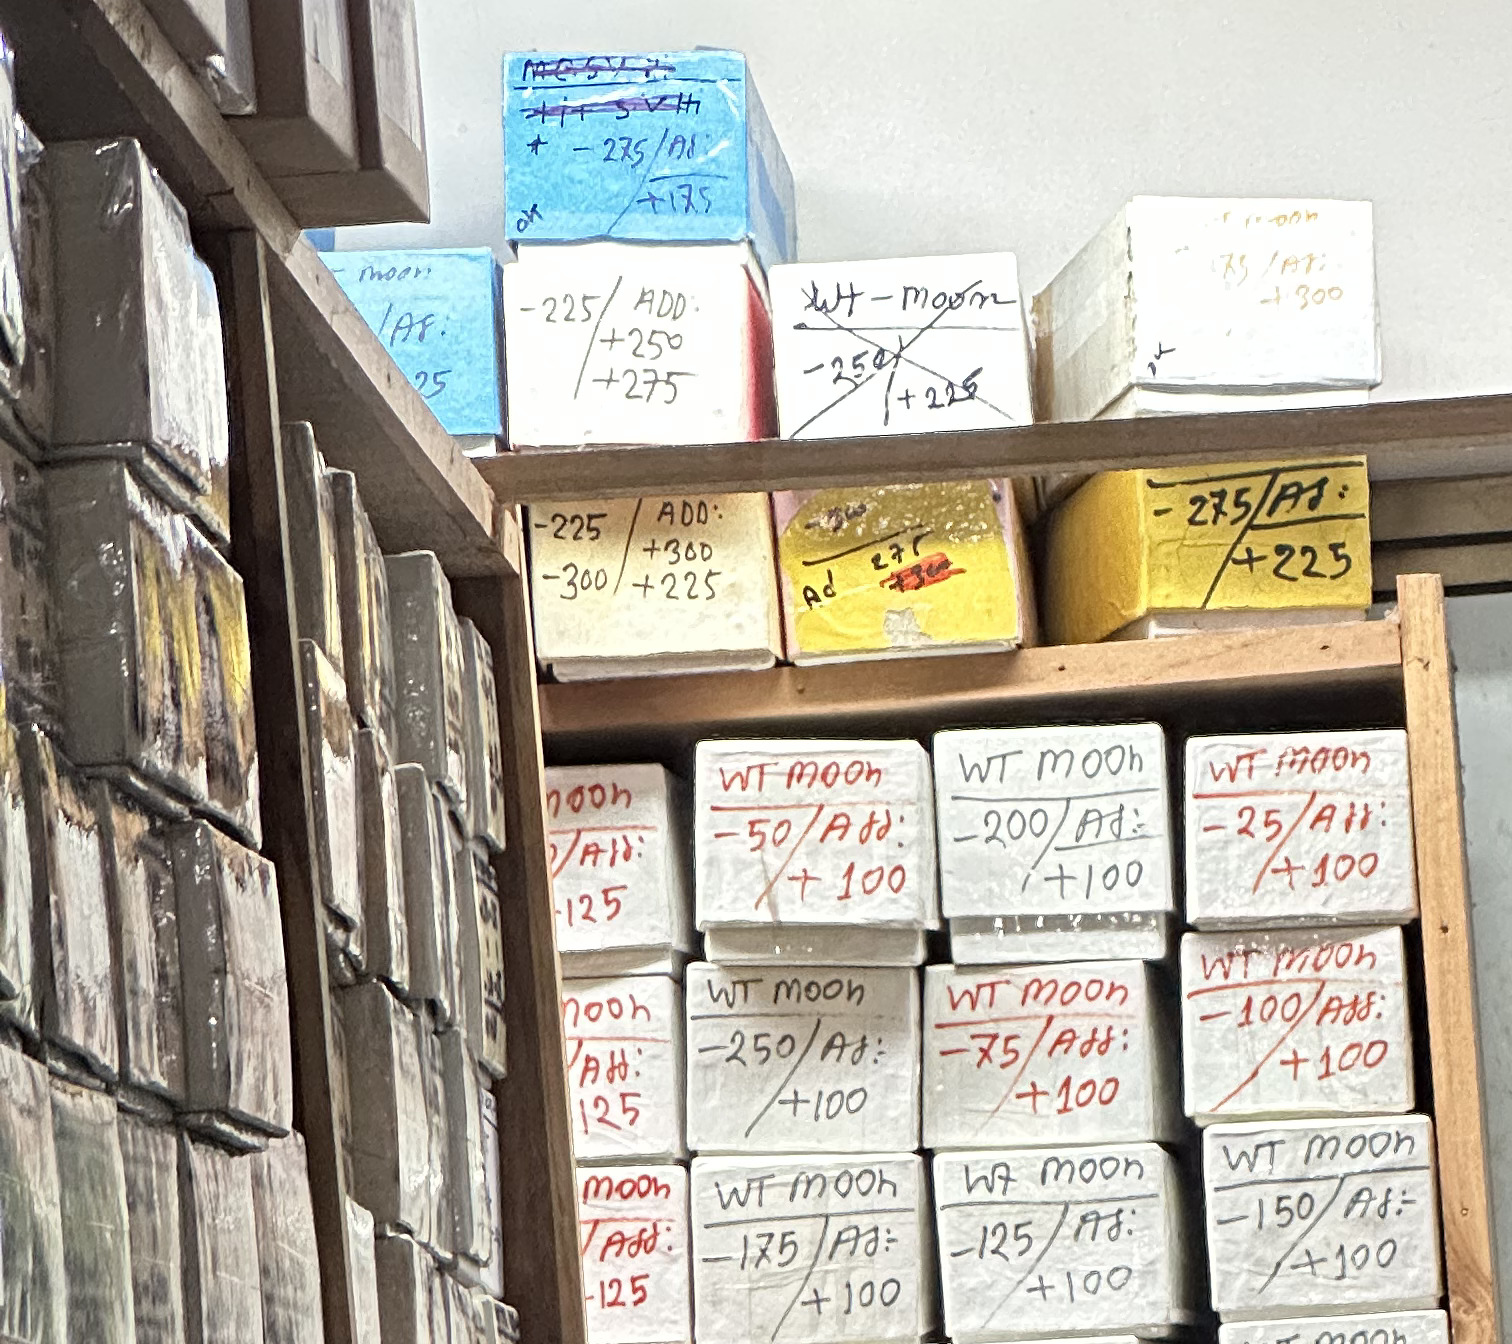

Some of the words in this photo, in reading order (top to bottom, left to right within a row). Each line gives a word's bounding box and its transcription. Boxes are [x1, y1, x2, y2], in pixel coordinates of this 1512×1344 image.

[601, 328, 684, 357] +250
[593, 369, 699, 404] +275
[643, 539, 713, 565] +300
[1230, 542, 1352, 581] +225
[632, 570, 723, 601] +225
[719, 762, 778, 792] WT
[957, 750, 1024, 784] WT
[1208, 747, 1266, 783] WT
[787, 861, 907, 901] +100
[1044, 860, 1144, 900] +100
[1270, 852, 1379, 891] +100
[1200, 947, 1263, 982] WT
[707, 978, 763, 1009] WT
[946, 978, 1010, 1012] WT
[1279, 1038, 1389, 1082] +100
[778, 1087, 868, 1122] +100
[1015, 1075, 1120, 1115] +100
[1223, 1139, 1286, 1175] WT
[715, 1174, 775, 1210] WT
[1289, 1239, 1398, 1280] +100
[801, 1278, 901, 1315] +100
[1026, 1265, 1133, 1302] +100
